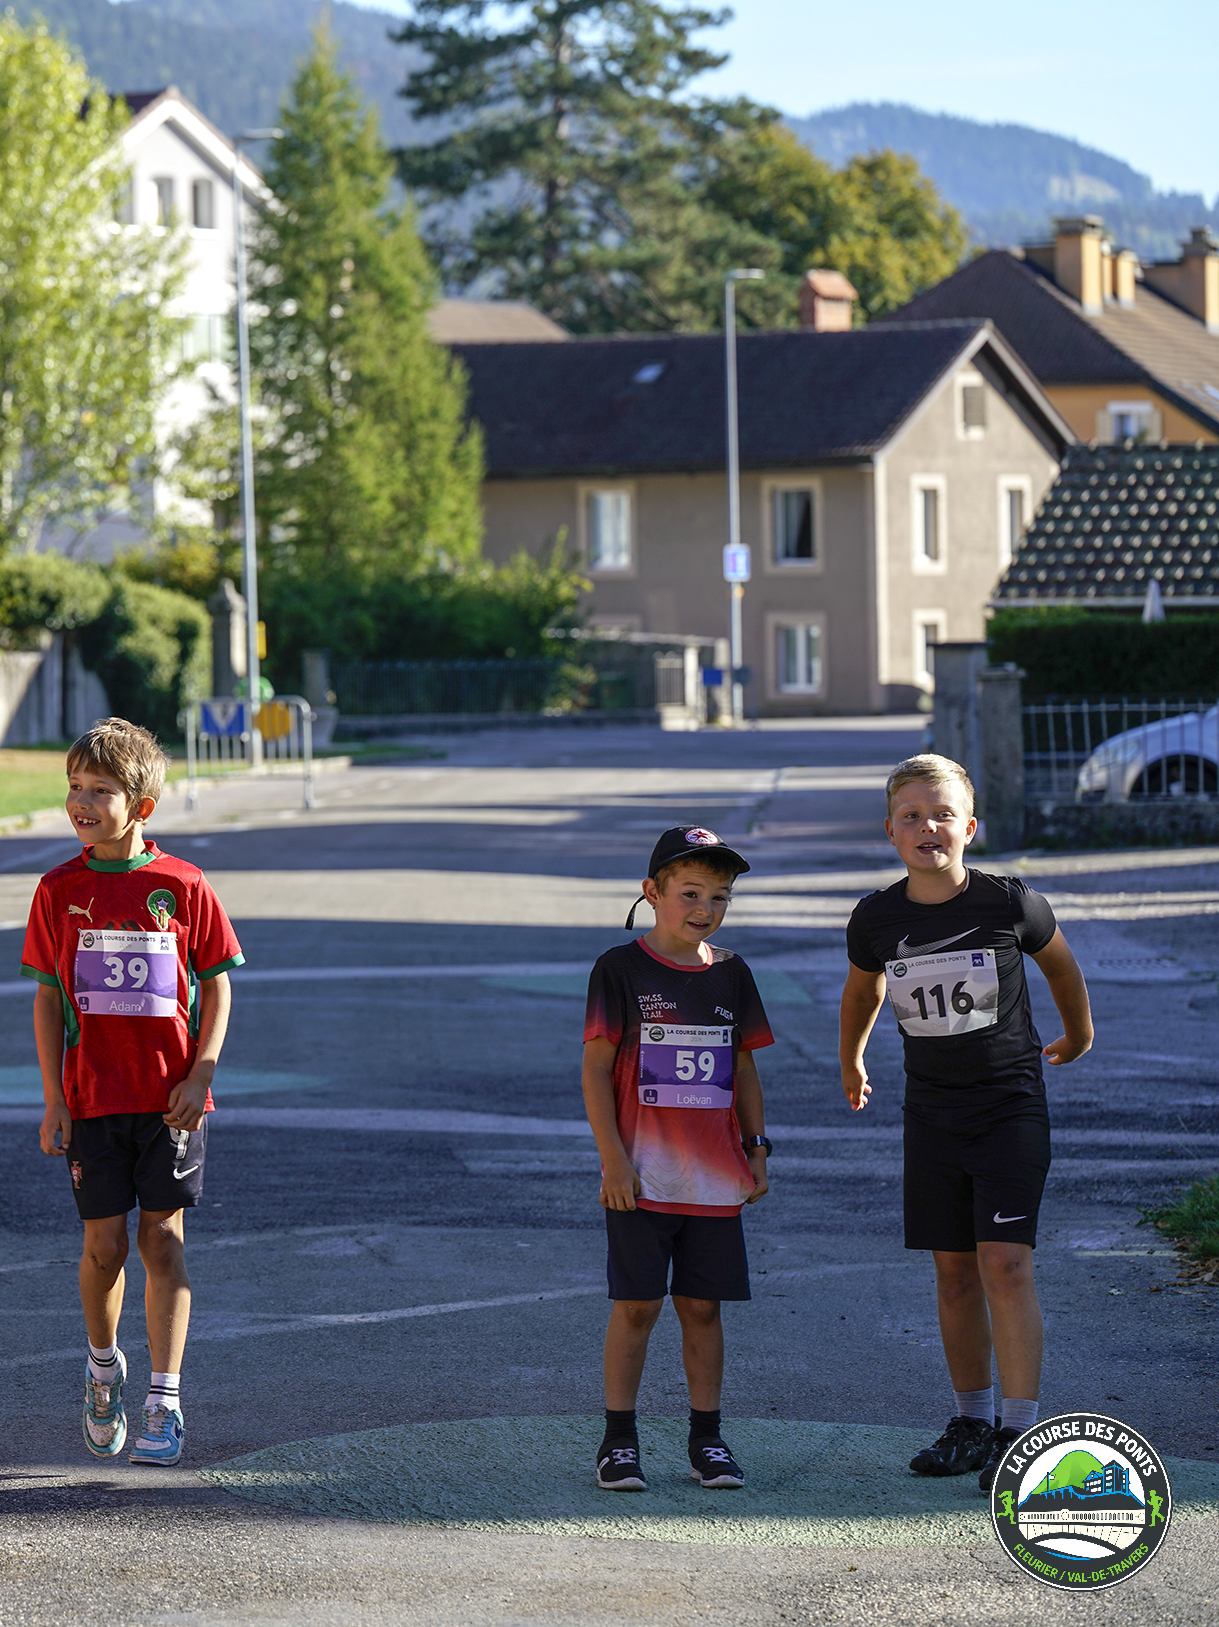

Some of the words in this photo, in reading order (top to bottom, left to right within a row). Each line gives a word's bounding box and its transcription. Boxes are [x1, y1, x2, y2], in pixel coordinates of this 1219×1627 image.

[104, 956, 148, 988] 39
[109, 1000, 141, 1012] Adam
[640, 1002, 677, 1011] CANYON
[910, 980, 974, 1020] 116
[675, 1050, 715, 1081] 59
[677, 1093, 711, 1104] Loëvan
